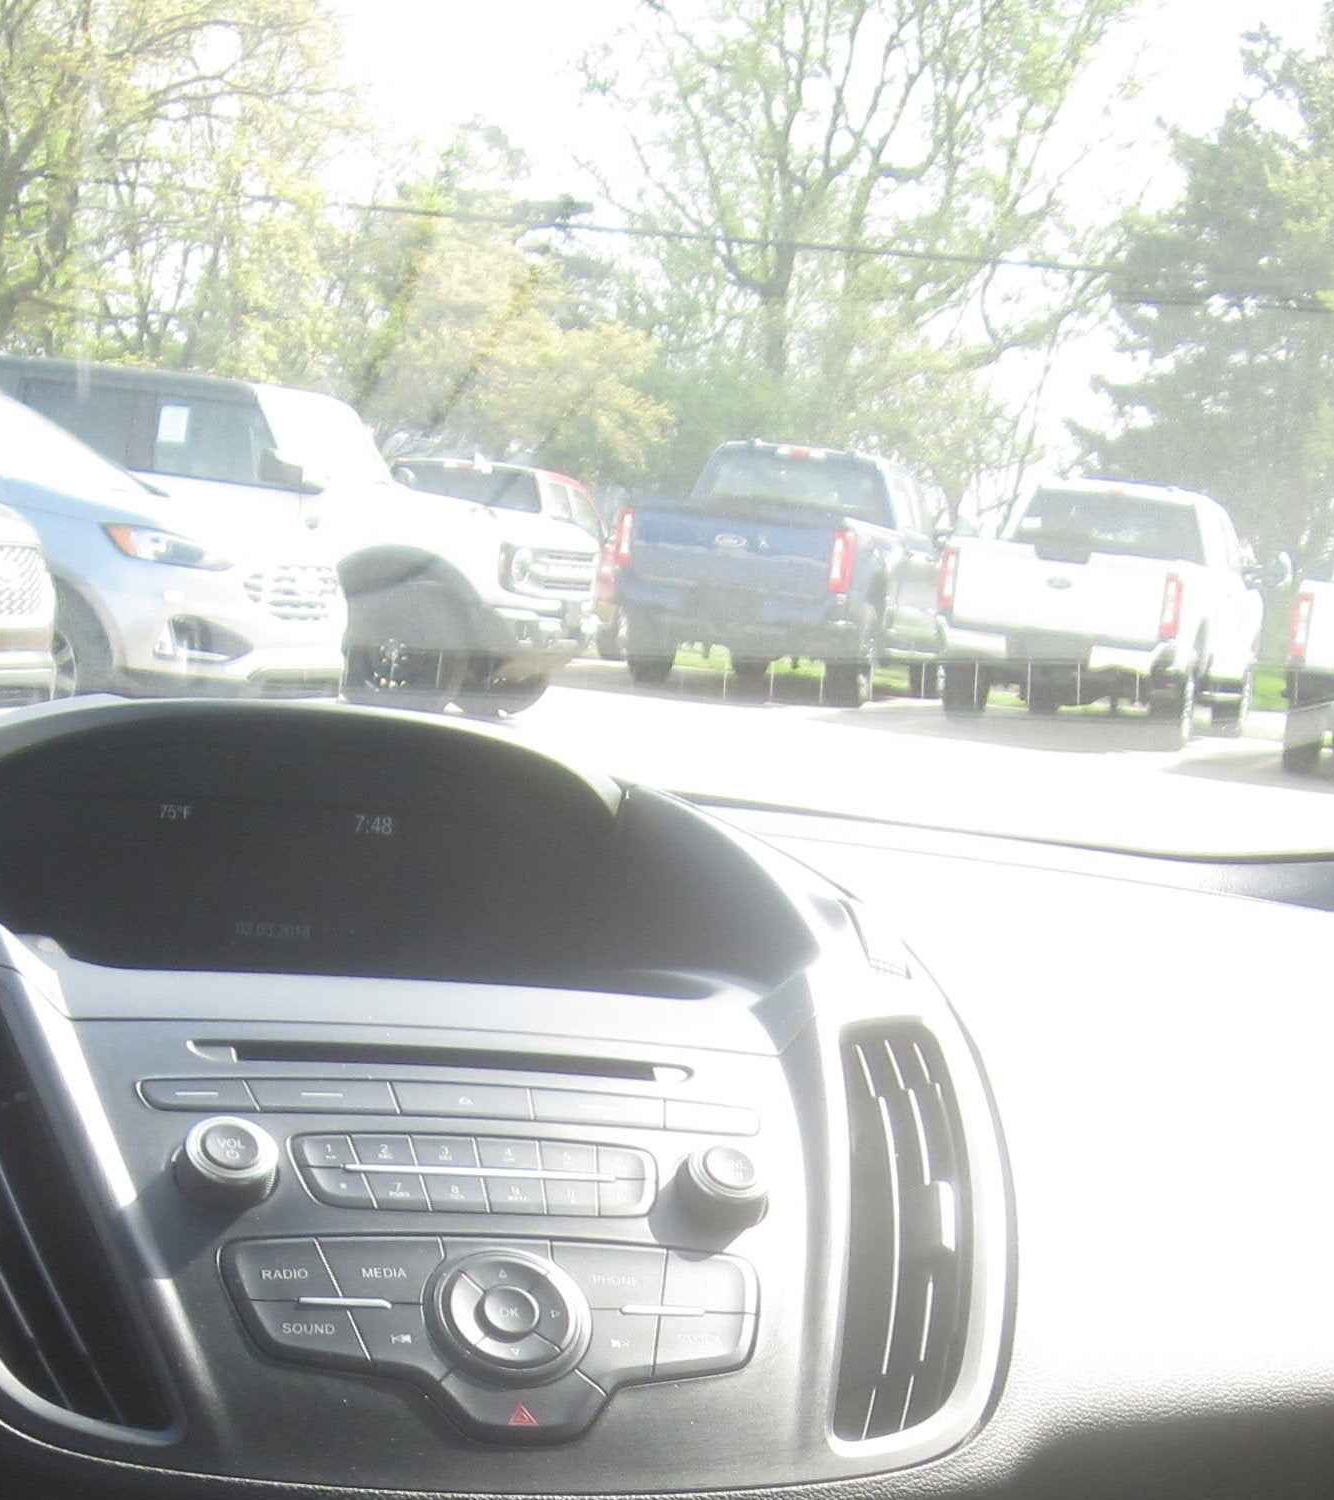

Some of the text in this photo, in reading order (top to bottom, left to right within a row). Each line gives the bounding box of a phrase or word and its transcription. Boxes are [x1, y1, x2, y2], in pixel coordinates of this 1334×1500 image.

[355, 814, 393, 836] 7:48
[216, 1137, 246, 1152] VOL
[261, 1268, 309, 1281] RADIO
[361, 1266, 408, 1279] MEDIA
[592, 1273, 639, 1287] PHONE
[498, 1306, 521, 1319] OK
[281, 1322, 336, 1336] SOUND
